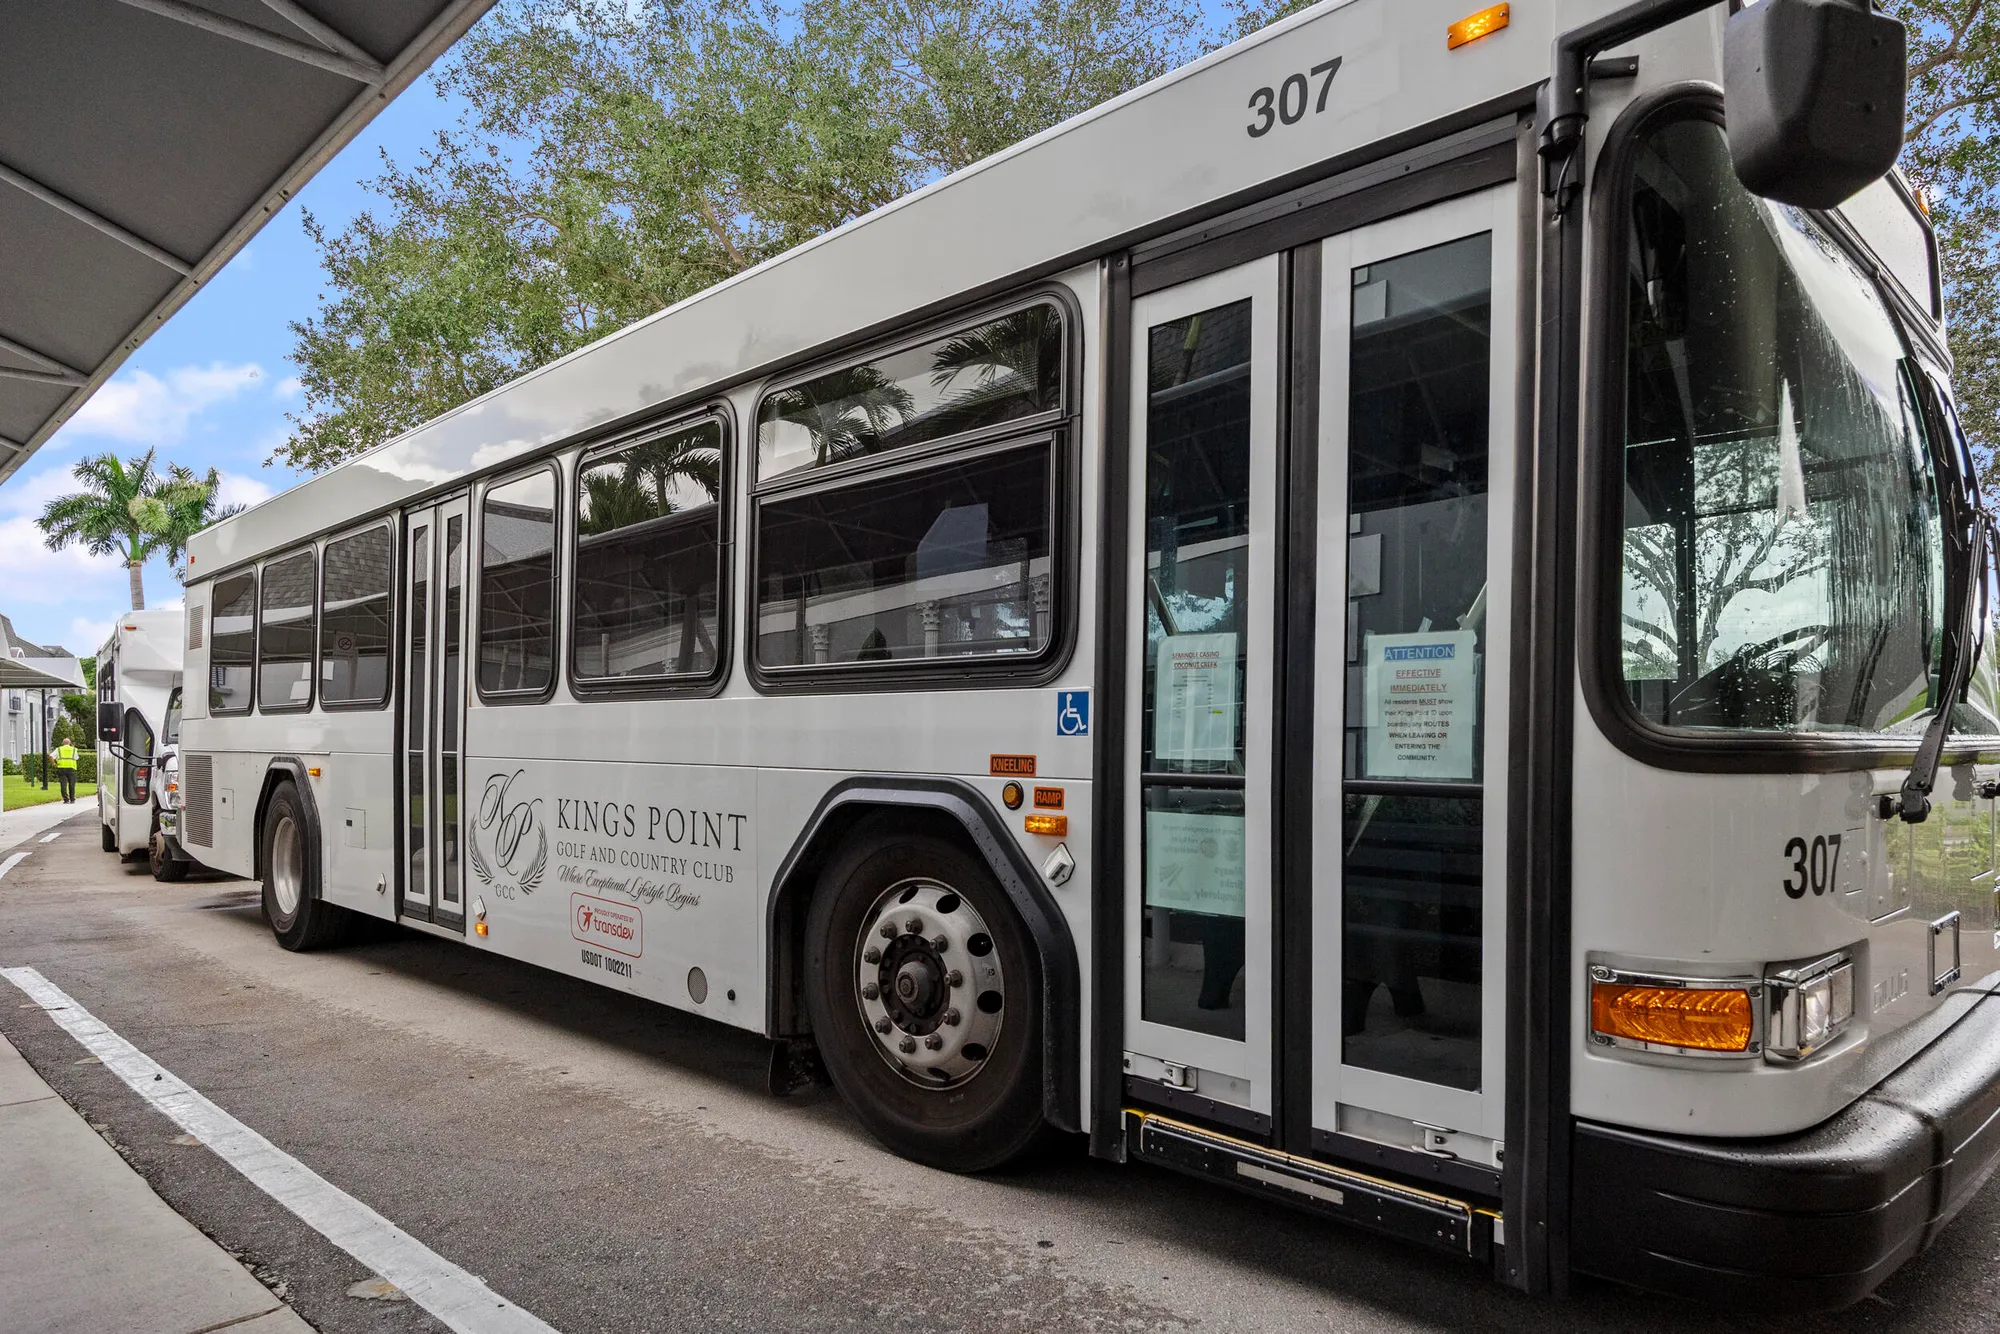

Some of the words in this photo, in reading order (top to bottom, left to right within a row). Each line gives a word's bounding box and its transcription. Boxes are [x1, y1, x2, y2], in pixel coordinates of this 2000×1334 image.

[1247, 55, 1343, 138] 307
[1385, 646, 1454, 659] ATTENTION
[1395, 668, 1441, 678] EFFECTIVE
[1390, 683, 1447, 693] IMMEDIATELY
[992, 758, 1033, 773] KNEELING
[1036, 791, 1061, 804] RAMP
[557, 798, 636, 838] KINGS
[648, 806, 747, 852] POINT
[556, 841, 586, 859] GOLF
[590, 847, 616, 864] AND
[620, 851, 687, 876] COUNTRY
[693, 861, 734, 883] CLUB
[1783, 833, 1842, 900] 307
[495, 884, 515, 900] GCC
[557, 864, 583, 884] Where
[584, 868, 629, 894] Exceptional
[626, 876, 665, 904] Lifestyle
[665, 882, 701, 910] Begins
[593, 916, 634, 940] transdev
[581, 949, 602, 968] USDOT
[605, 957, 632, 978] 1002211
